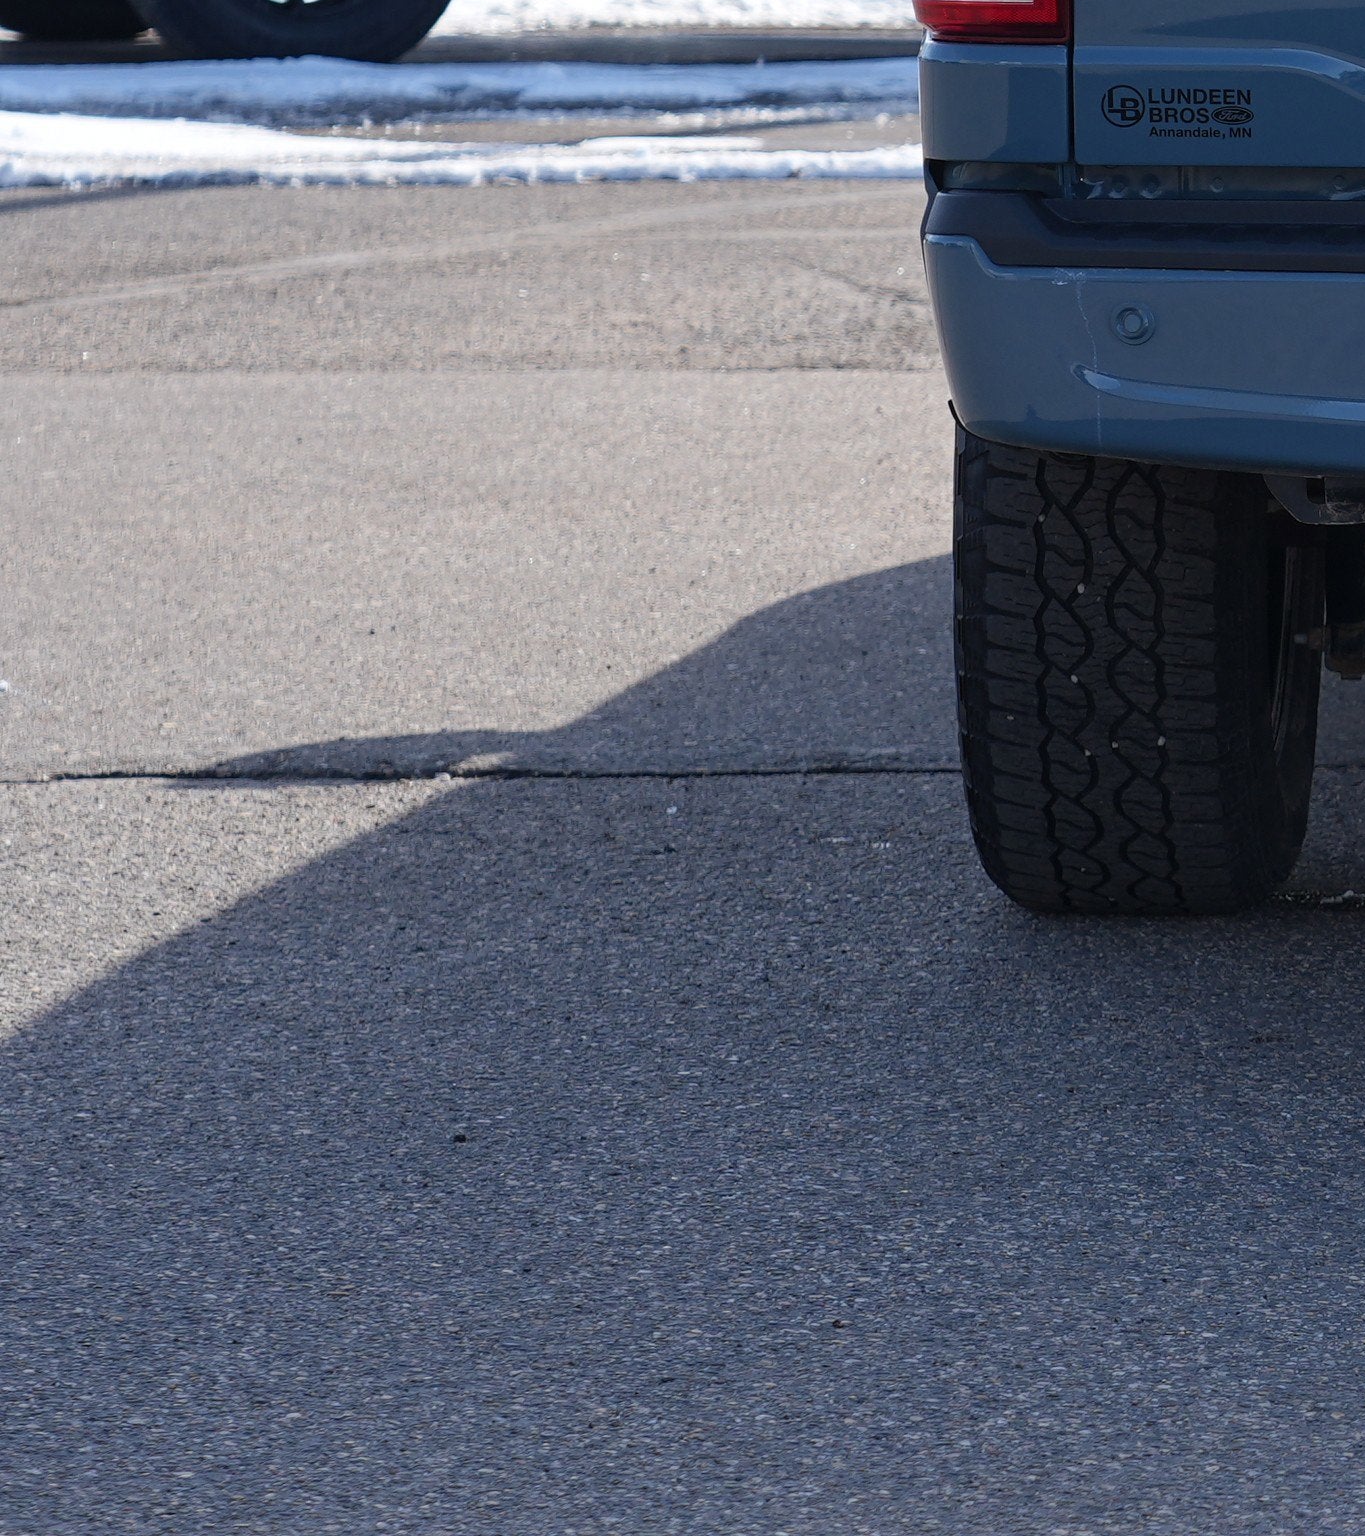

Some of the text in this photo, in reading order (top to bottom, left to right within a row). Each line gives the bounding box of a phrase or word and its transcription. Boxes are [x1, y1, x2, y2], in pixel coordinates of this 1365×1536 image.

[1148, 88, 1251, 105] LUNDEEN
[1150, 108, 1210, 124] BROS
[1149, 127, 1252, 139] Annandale, MN
